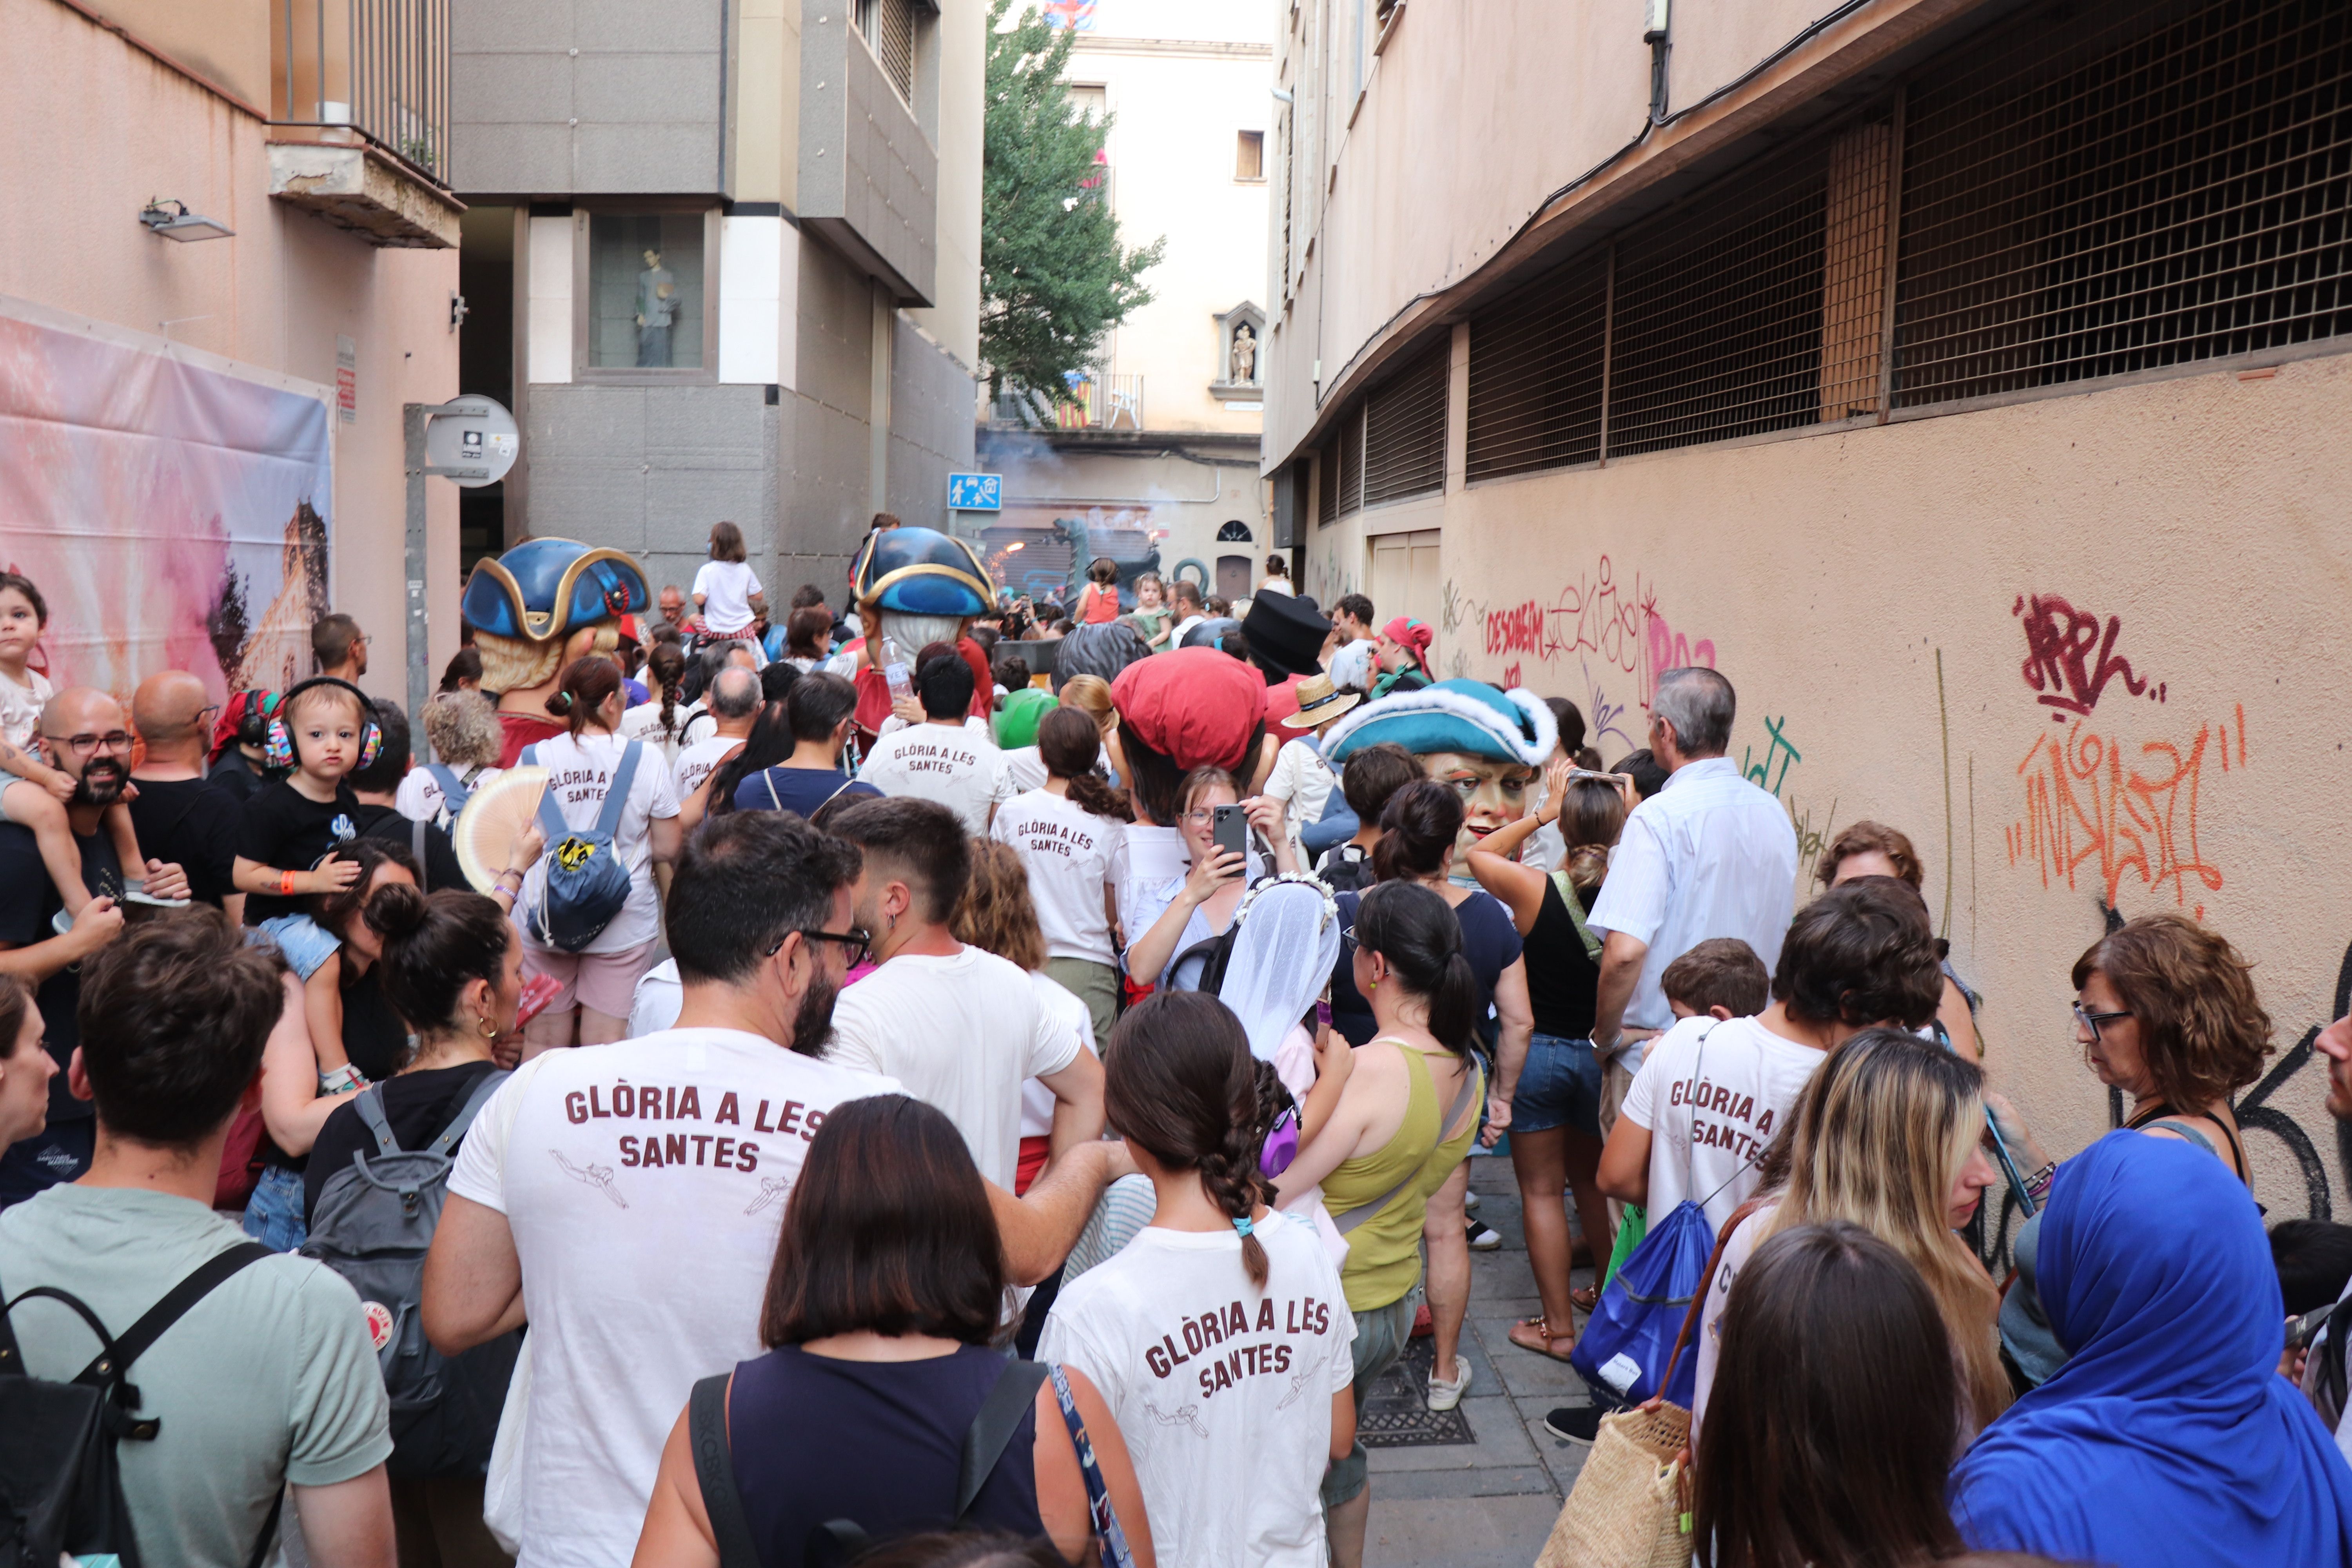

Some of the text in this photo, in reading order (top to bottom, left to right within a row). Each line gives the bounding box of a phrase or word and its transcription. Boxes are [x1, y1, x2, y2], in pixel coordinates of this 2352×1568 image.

[895, 743, 976, 766] GLÒRIA A LES
[909, 759, 953, 774] SANTES
[549, 769, 606, 791] GLÒRIA A
[1019, 818, 1093, 850] GLÒRIA A LES
[1031, 840, 1071, 857] SANTES
[565, 1078, 827, 1142] GLÒRIA A LES
[1671, 1076, 1774, 1135] GLÒRIA A
[620, 1134, 760, 1172] SANTES
[1145, 1297, 1328, 1378] GLÒRIA A LES
[1199, 1342, 1292, 1398] SANTES
